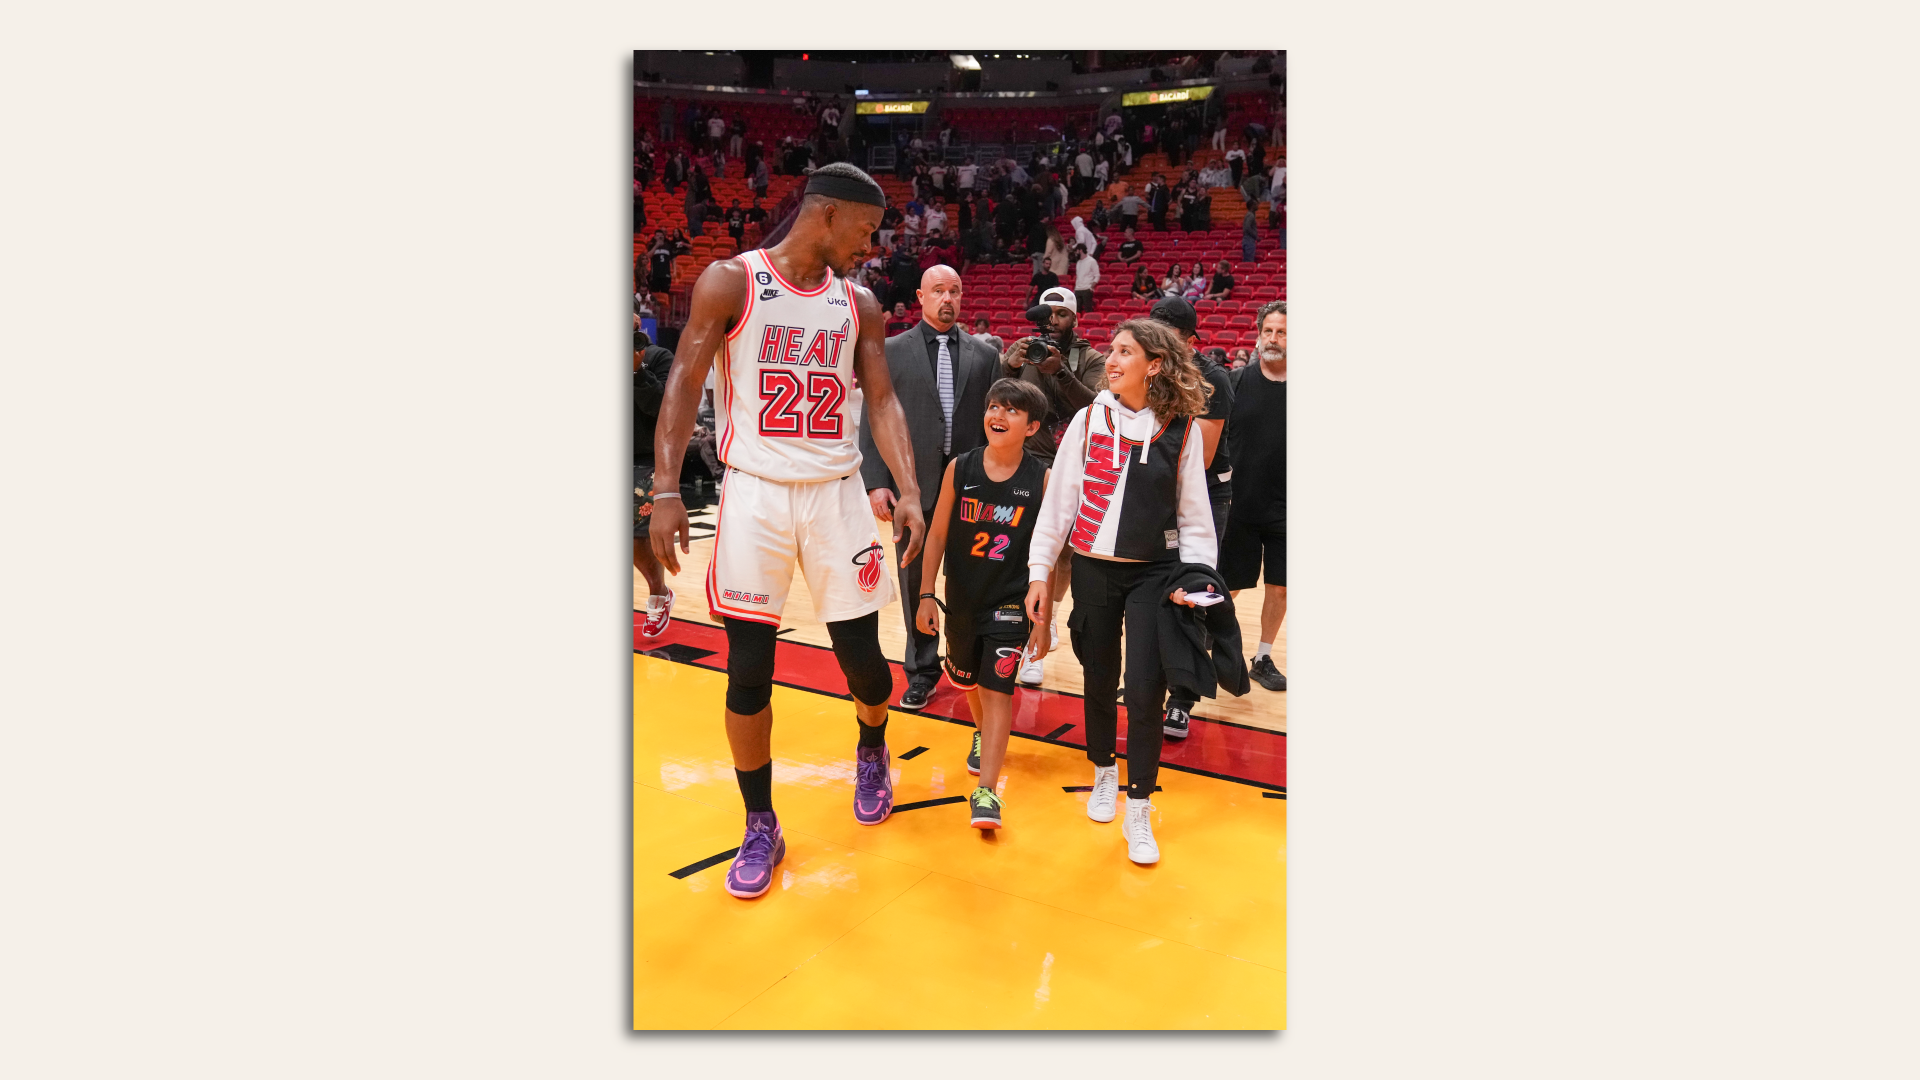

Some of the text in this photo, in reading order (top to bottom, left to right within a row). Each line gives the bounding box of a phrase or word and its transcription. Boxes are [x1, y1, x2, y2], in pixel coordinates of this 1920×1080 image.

[827, 297, 848, 306] UKG
[758, 318, 850, 368] HEAT
[759, 369, 846, 439] 22
[1013, 488, 1030, 497] UKG
[1068, 432, 1132, 553] MIAMI
[970, 531, 1010, 561] 22
[723, 589, 769, 604] MIAMI
